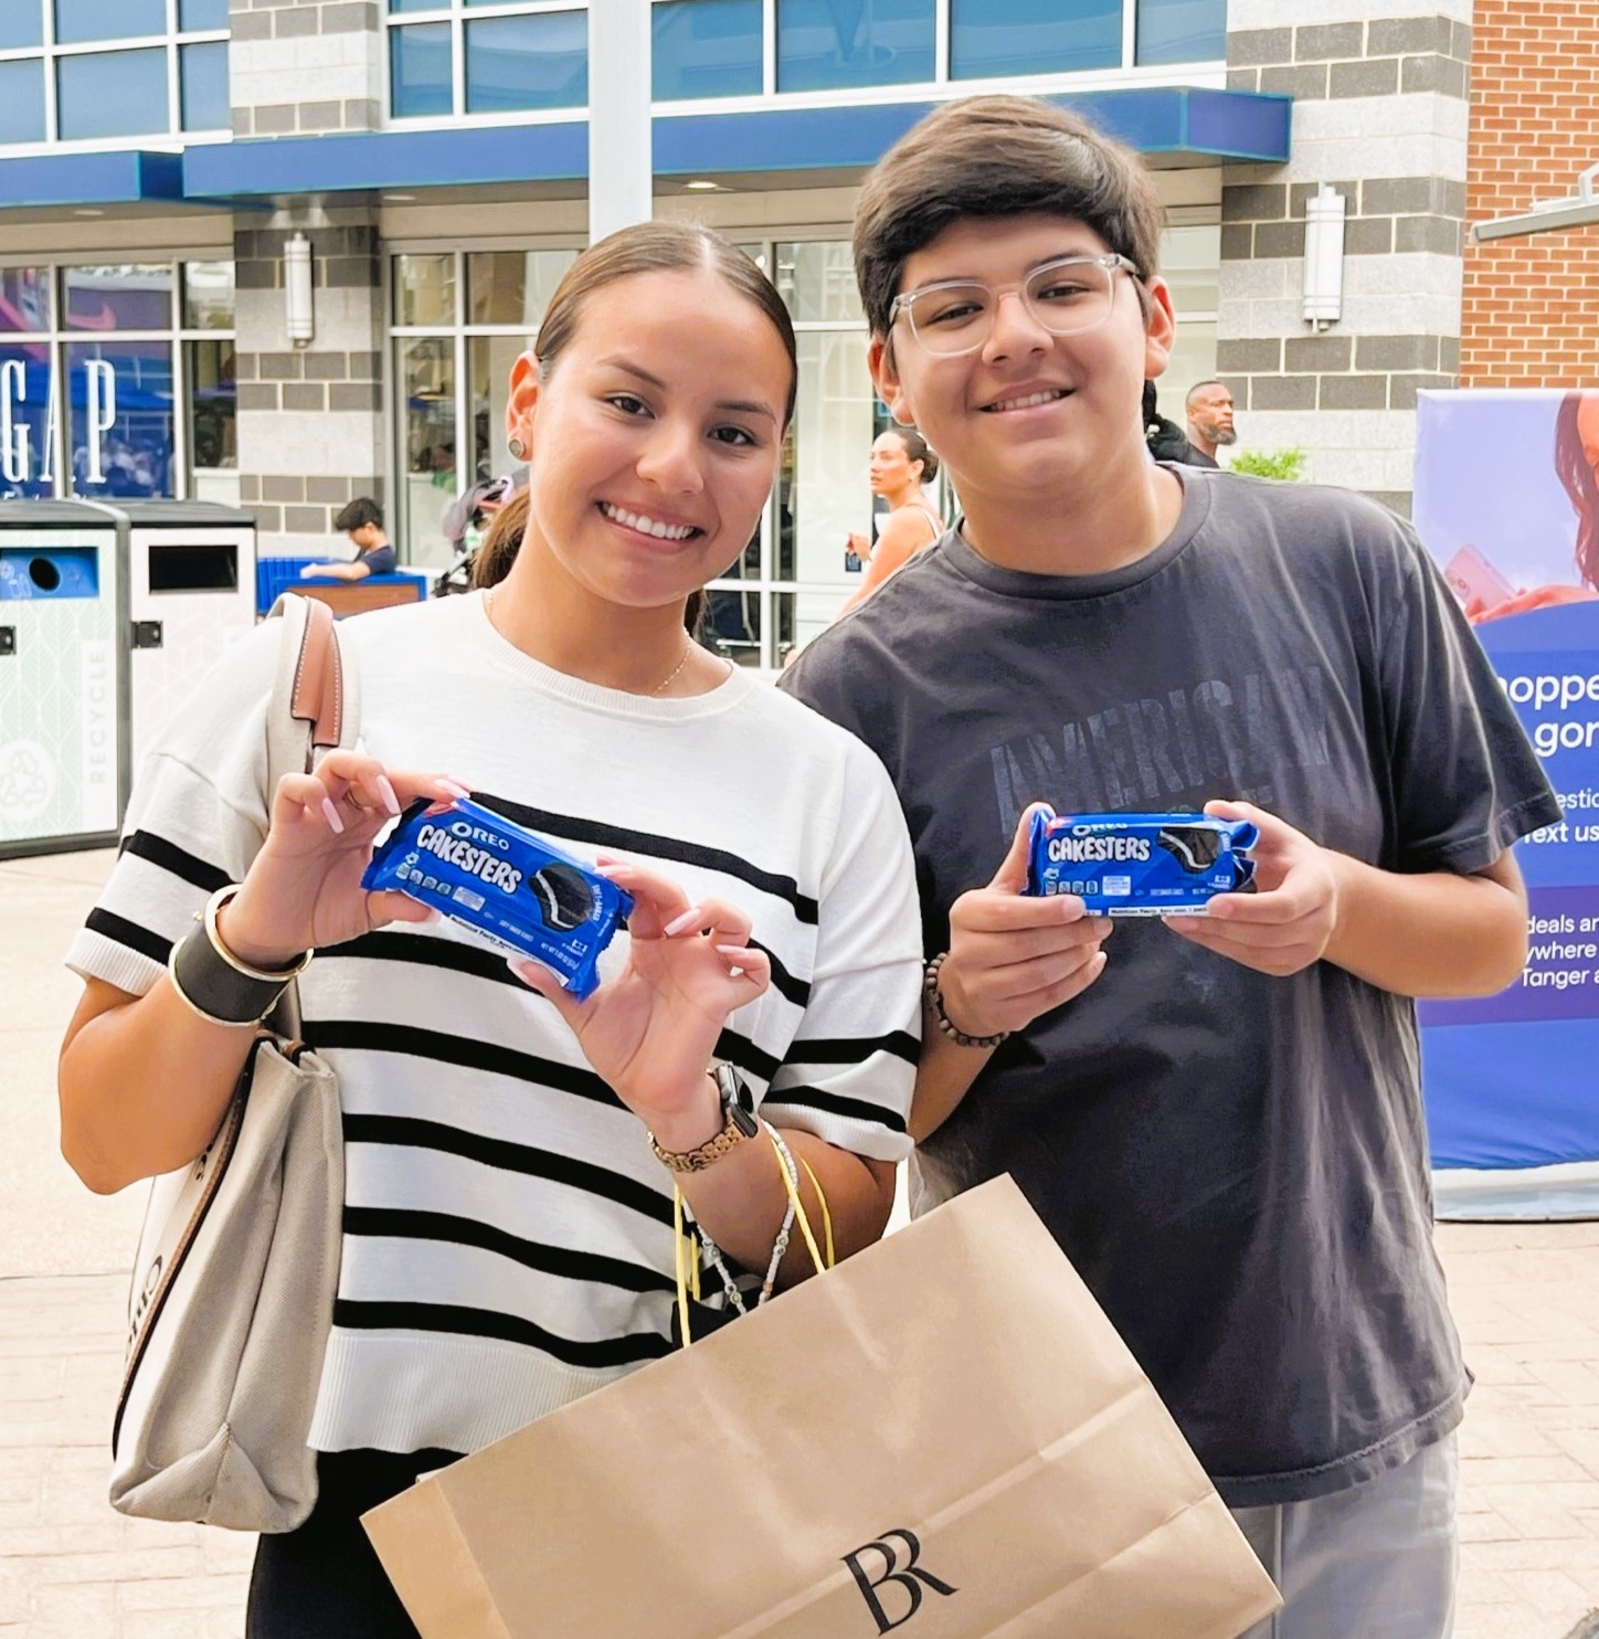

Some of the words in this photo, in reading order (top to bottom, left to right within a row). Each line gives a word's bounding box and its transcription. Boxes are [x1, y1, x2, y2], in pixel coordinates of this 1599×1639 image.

[1496, 674, 1599, 711] oppe
[89, 651, 107, 784] RECYCLE
[451, 822, 510, 851] OREO
[1048, 836, 1151, 862] CAKESTERS
[416, 824, 523, 894] CAKESTERS
[1522, 968, 1591, 990] Tanger
[839, 1528, 961, 1637] BR
